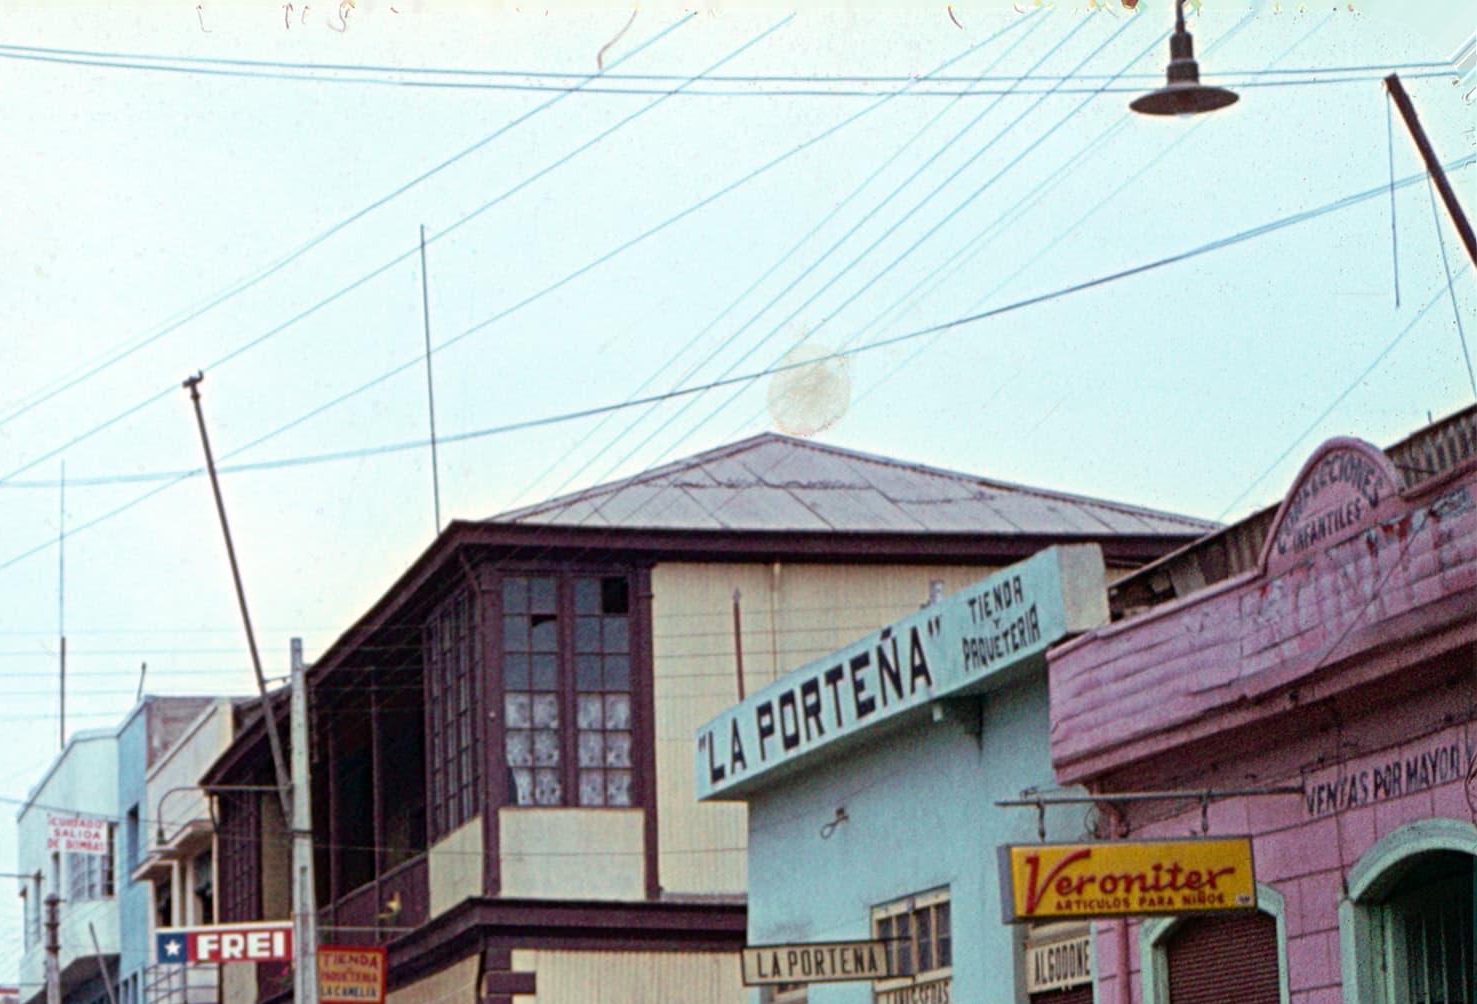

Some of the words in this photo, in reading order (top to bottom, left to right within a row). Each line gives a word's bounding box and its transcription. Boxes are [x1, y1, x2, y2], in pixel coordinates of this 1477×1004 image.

[1292, 498, 1362, 553] INFANTILES
[968, 574, 1024, 625] TIENDA
[962, 602, 1041, 672] PAQUETERIA
[1306, 769, 1369, 816] VENTAS
[1373, 760, 1403, 800] POR
[1406, 743, 1461, 794] MAYOR
[54, 828, 101, 839] SALIDA
[1025, 847, 1236, 916] Veroniter
[1054, 897, 1132, 912] ARTICULOS
[1139, 895, 1174, 907] PARA
[1182, 890, 1225, 906] NIÑOS
[196, 931, 286, 961] FREI
[323, 953, 379, 969] TIENDA
[756, 951, 782, 978] LA
